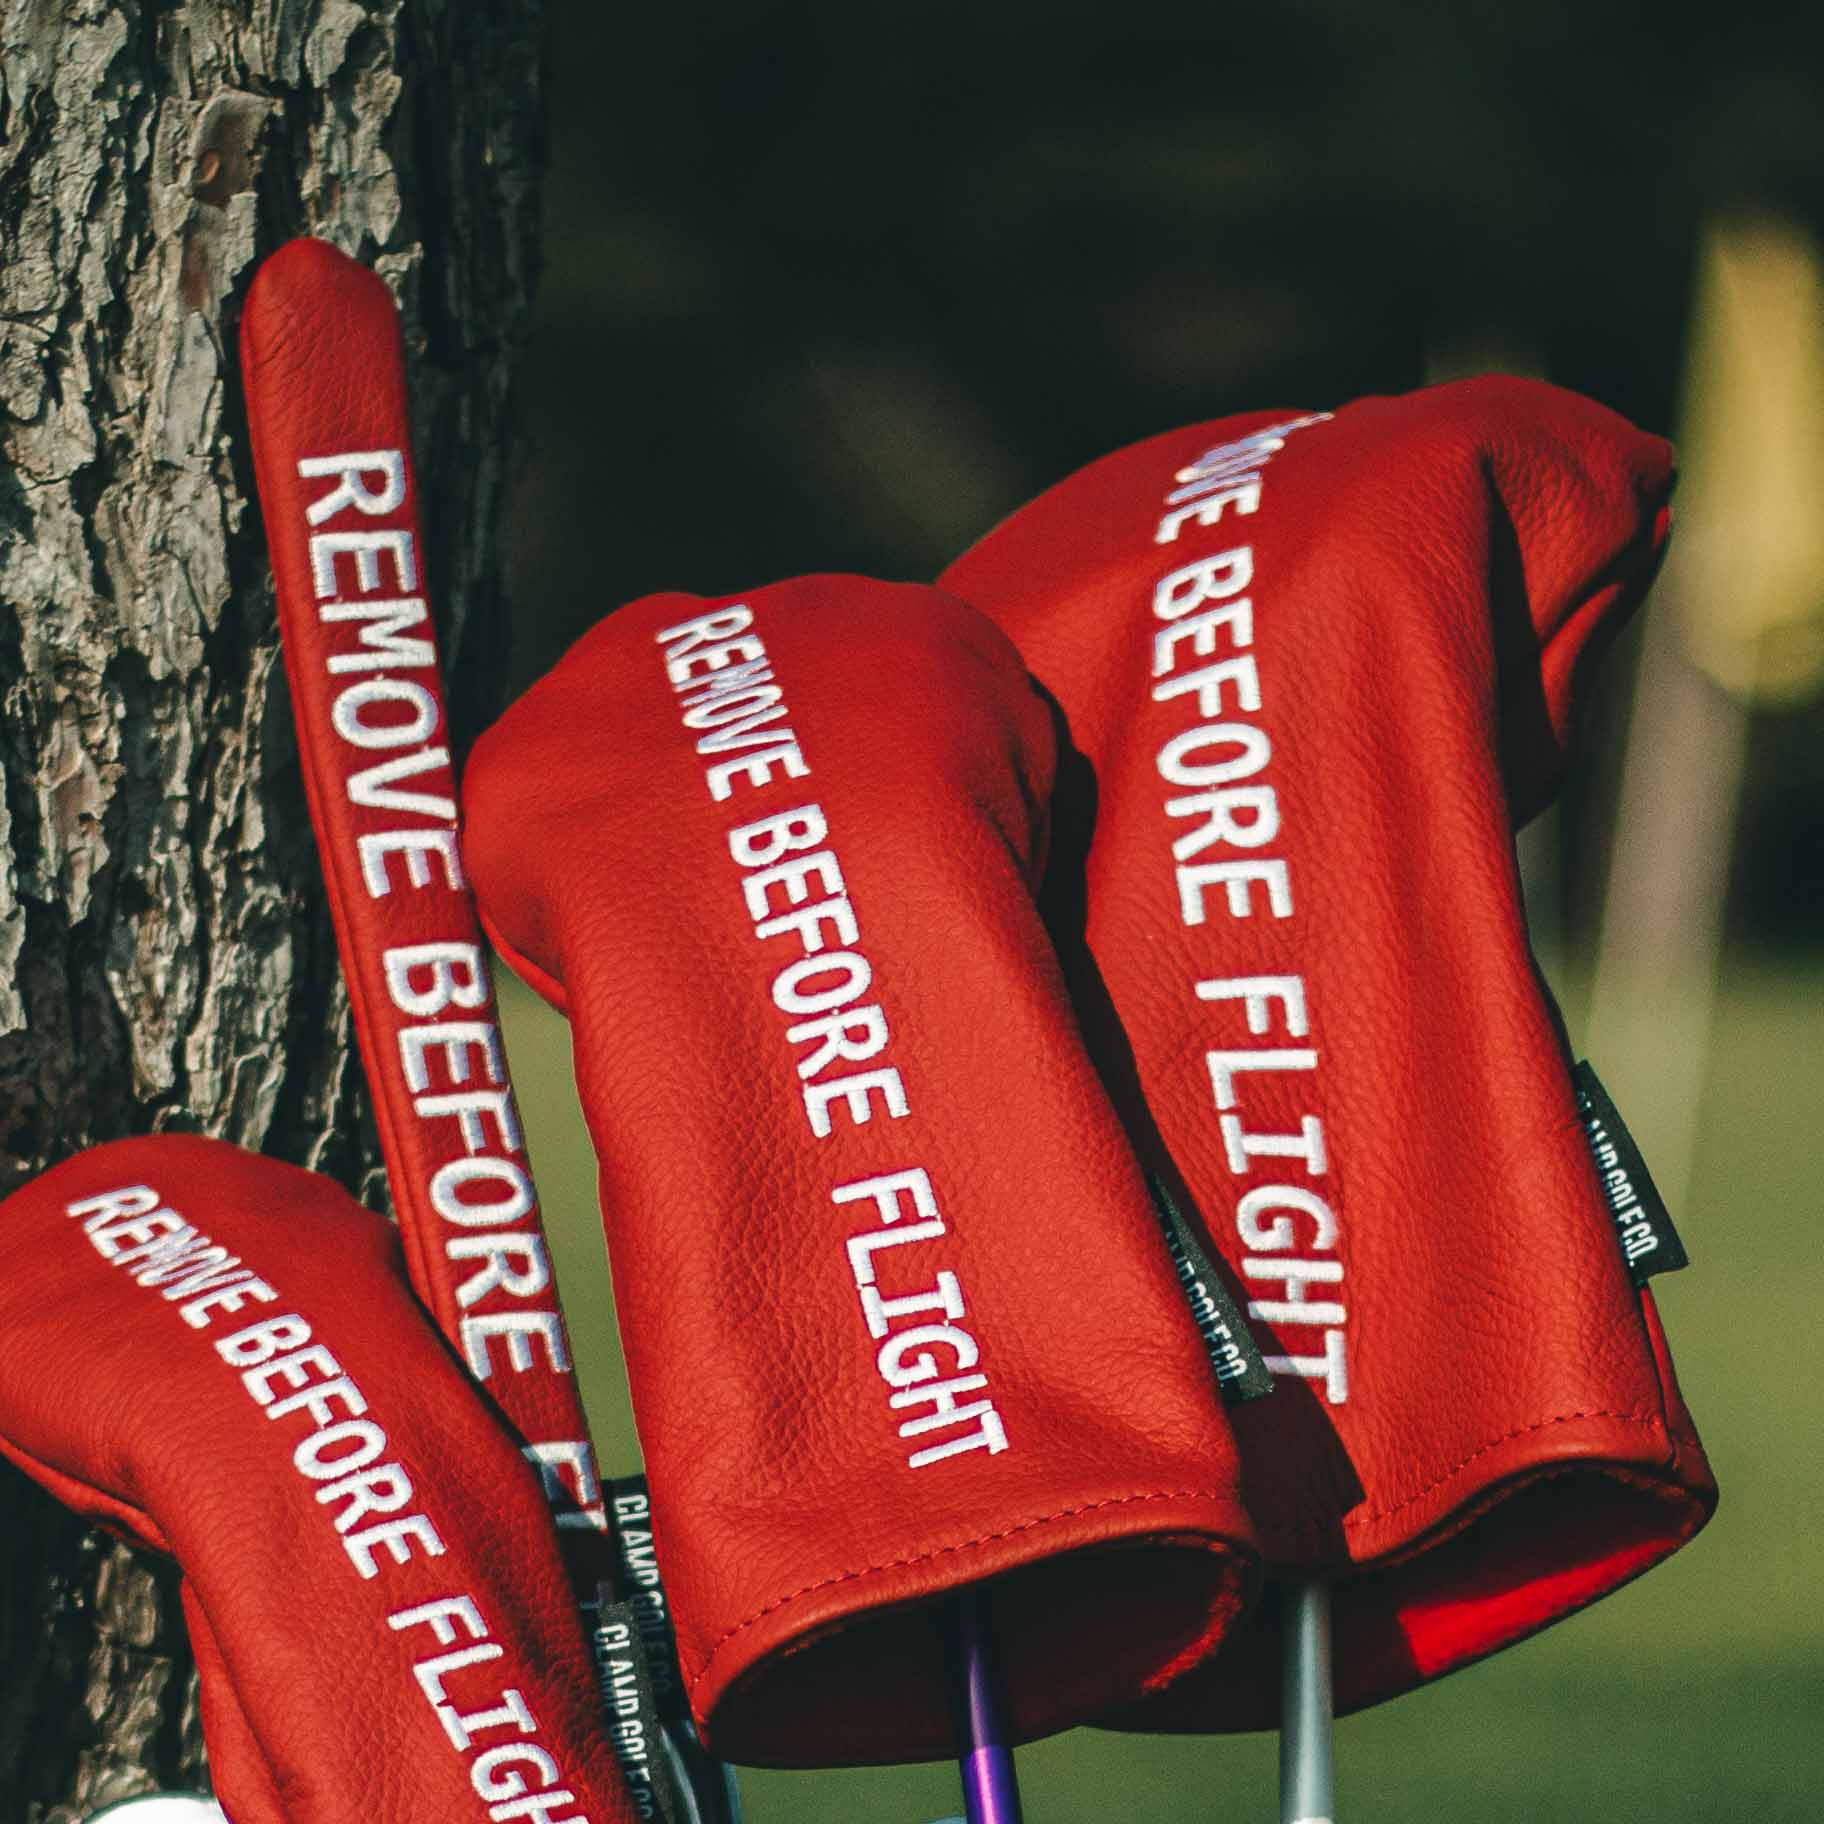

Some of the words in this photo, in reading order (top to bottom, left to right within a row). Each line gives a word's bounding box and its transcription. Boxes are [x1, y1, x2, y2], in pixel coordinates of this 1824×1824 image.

[654, 603, 813, 803] REMOVE
[1150, 544, 1295, 928] BEFORE
[296, 448, 463, 900] REMOVE
[381, 941, 572, 1383] BEFORE
[727, 802, 913, 1140] BEFORE
[829, 1166, 1010, 1470] FLIGHT
[1193, 973, 1350, 1406] FLIGHT
[65, 1183, 280, 1330] REMOVE
[212, 1312, 448, 1581] BEFORE
